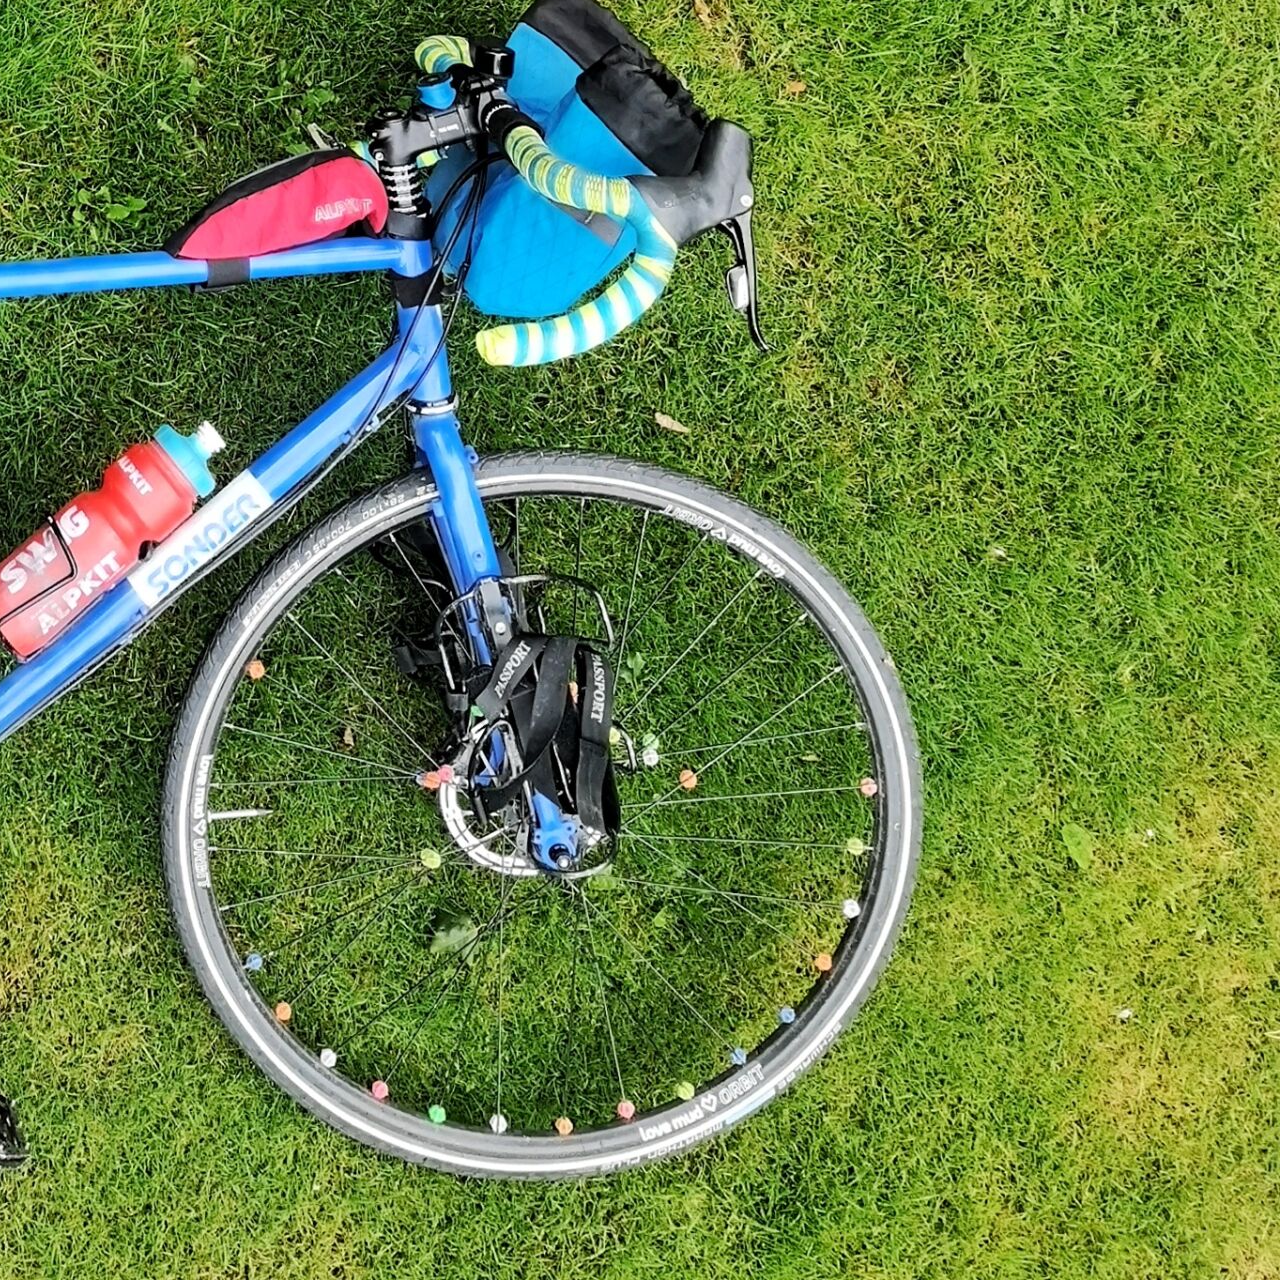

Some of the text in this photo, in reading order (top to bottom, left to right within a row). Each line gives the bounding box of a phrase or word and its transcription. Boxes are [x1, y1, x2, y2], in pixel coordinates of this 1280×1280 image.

[147, 492, 261, 598] SONDER
[662, 503, 714, 530] ORBIT
[38, 550, 122, 635] ALPKIT
[494, 640, 532, 700] PASSPORT
[589, 652, 606, 724] PASSPORT
[193, 786, 206, 820] mud
[193, 838, 212, 889] ORBIT
[671, 1103, 705, 1130] mud
[718, 1062, 766, 1106] ORBIT
